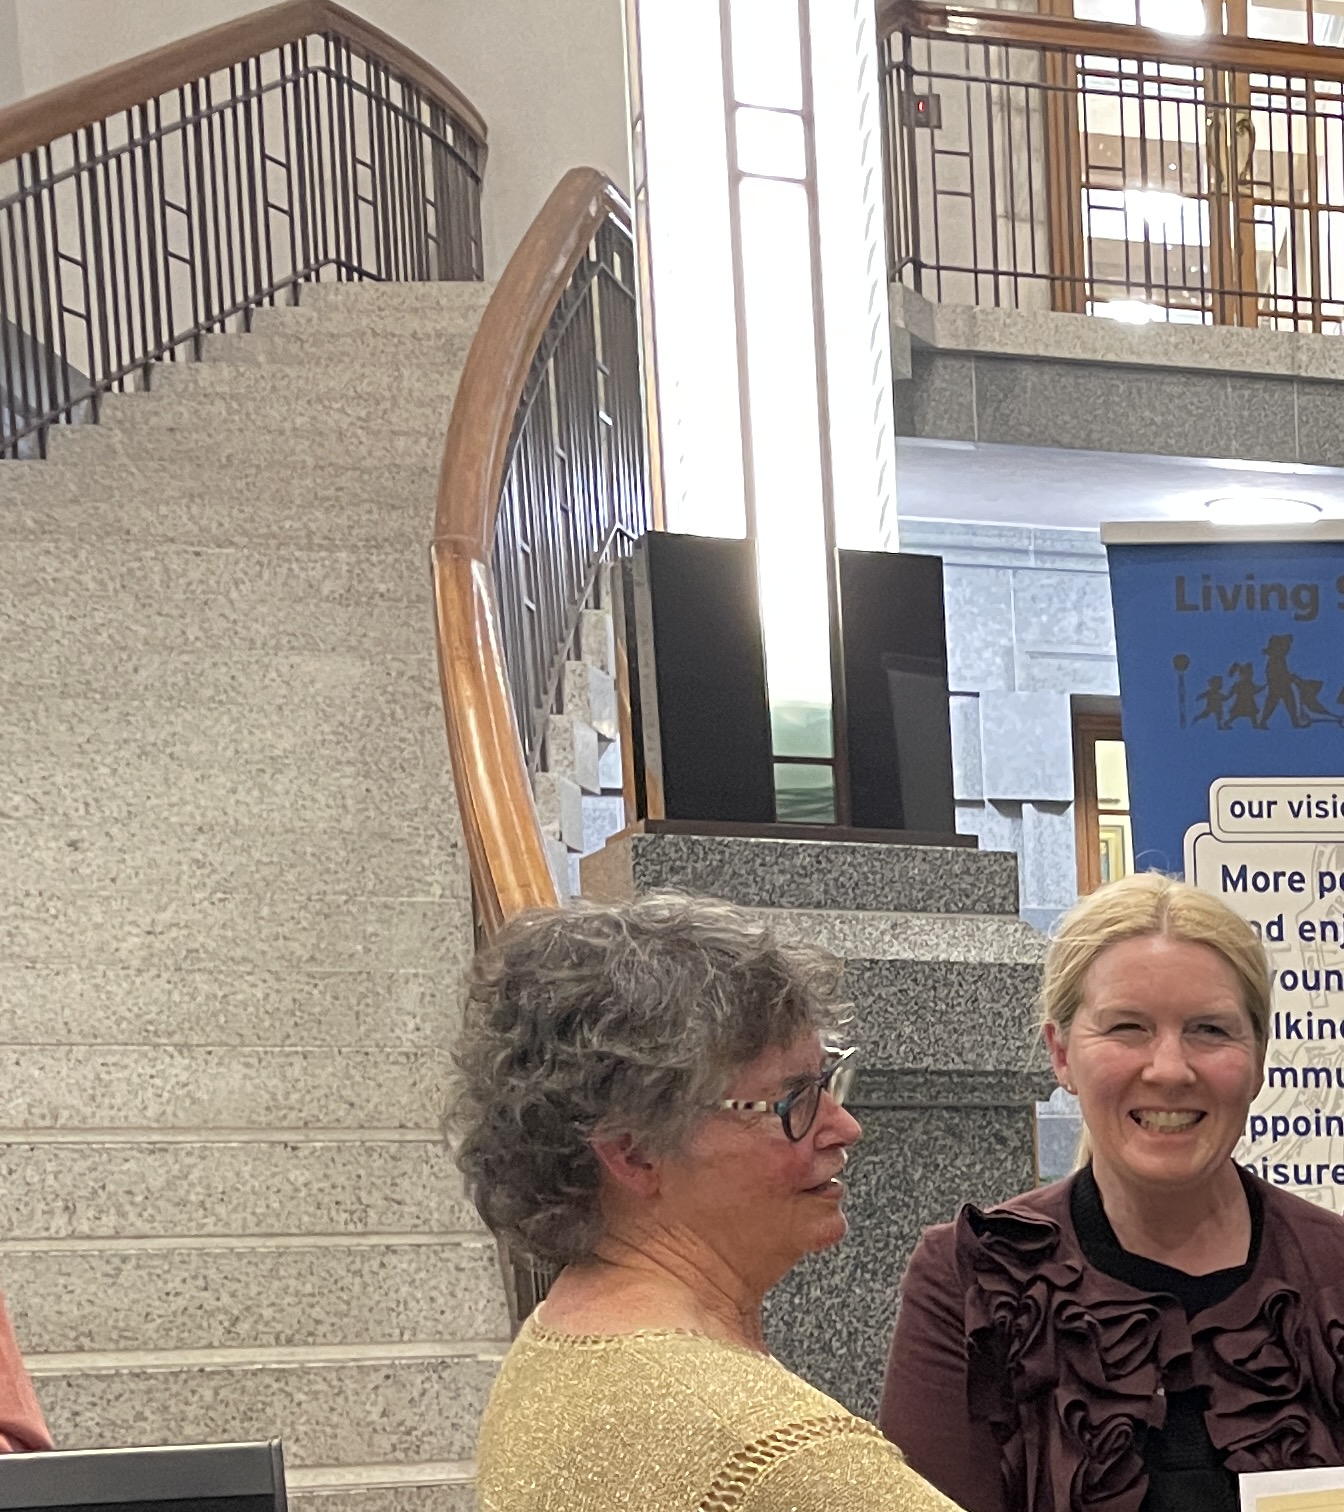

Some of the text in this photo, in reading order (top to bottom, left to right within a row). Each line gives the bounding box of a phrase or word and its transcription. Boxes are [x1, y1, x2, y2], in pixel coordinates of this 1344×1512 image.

[1174, 573, 1319, 622] Living
[1229, 799, 1277, 819] our
[1221, 864, 1306, 893] More
[1250, 913, 1284, 942] nd
